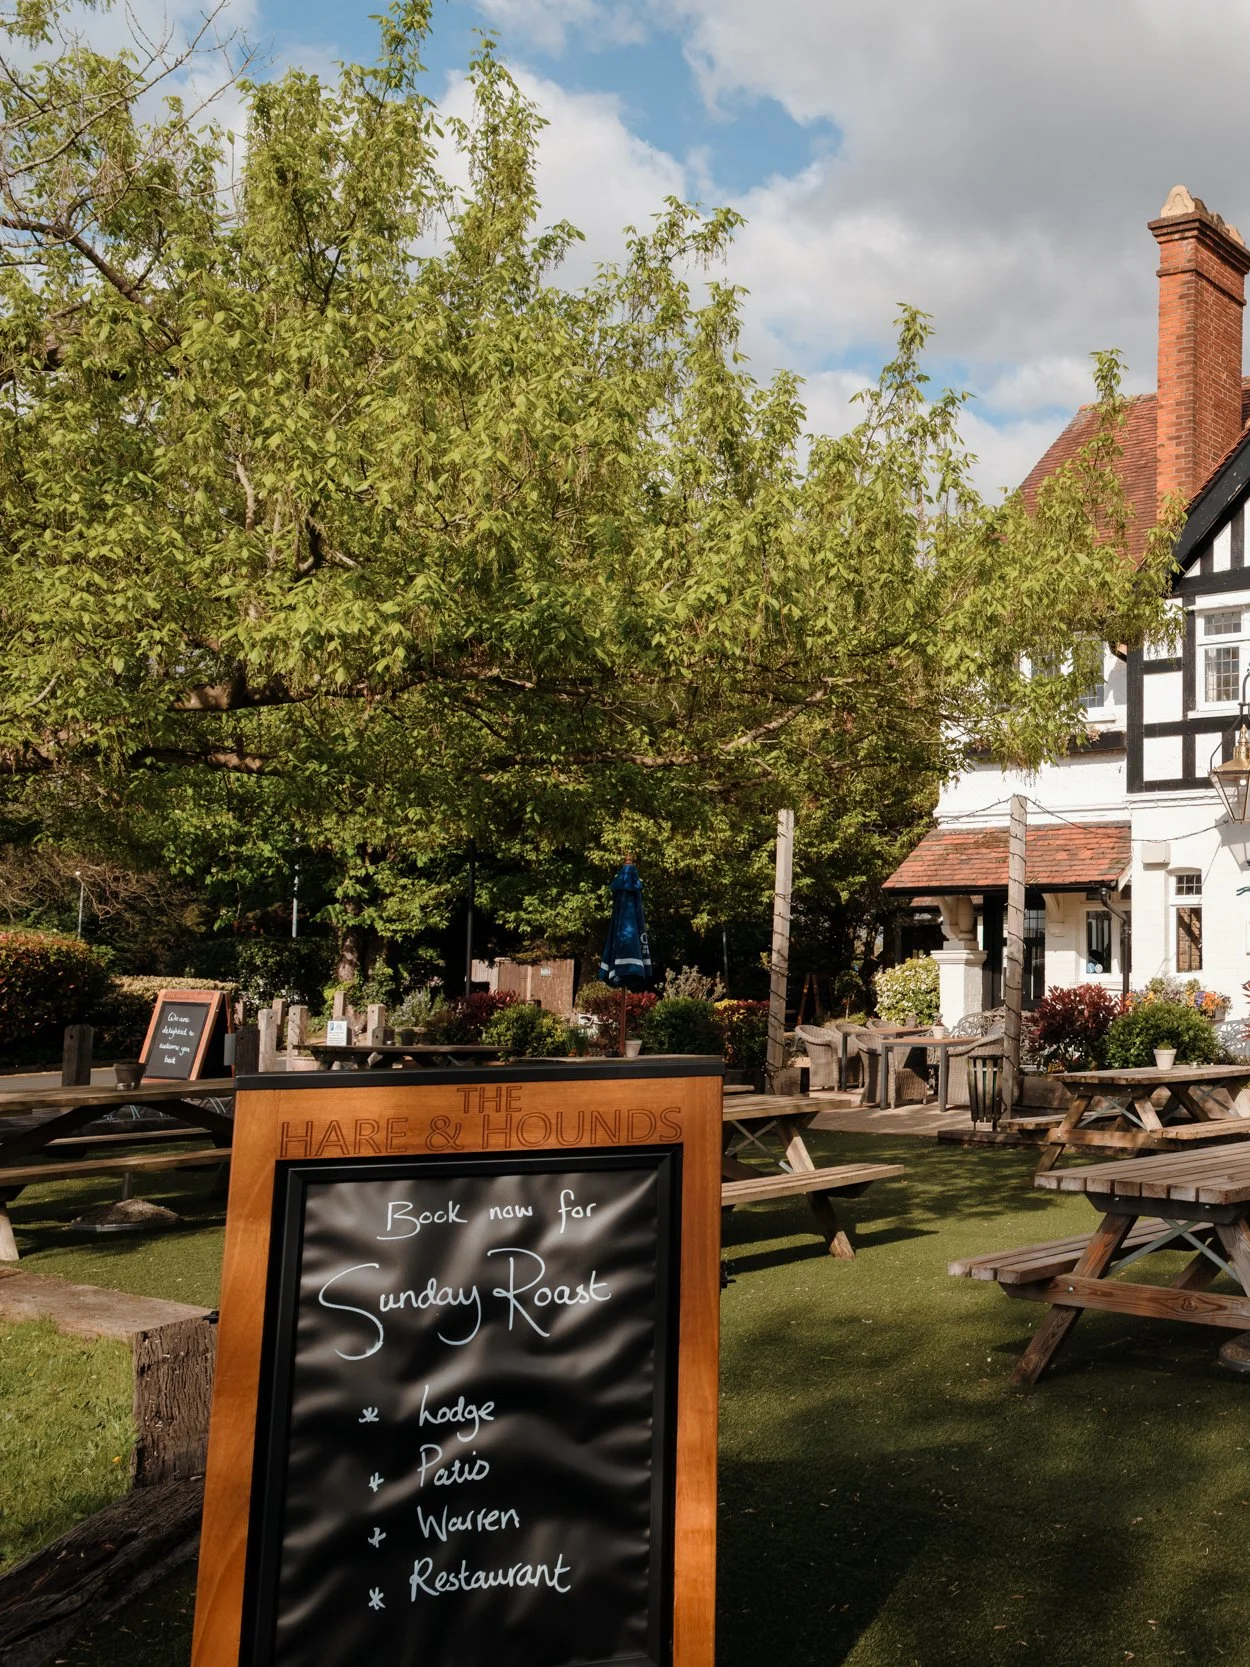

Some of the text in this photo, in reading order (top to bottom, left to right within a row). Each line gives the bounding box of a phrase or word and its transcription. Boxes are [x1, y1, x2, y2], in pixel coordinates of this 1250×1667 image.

[162, 1026, 187, 1040] delighted
[168, 1012, 178, 1021] We
[179, 1046, 190, 1056] you
[456, 1085, 522, 1114] THE
[279, 1107, 683, 1158] HARE & HOUNDS
[376, 1189, 596, 1240] Book now for
[318, 1248, 611, 1361] Sunday Roast
[419, 1384, 495, 1442] Lodge
[417, 1443, 490, 1488] Patio
[417, 1505, 520, 1542] Warren
[409, 1553, 571, 1602] Restaurant
